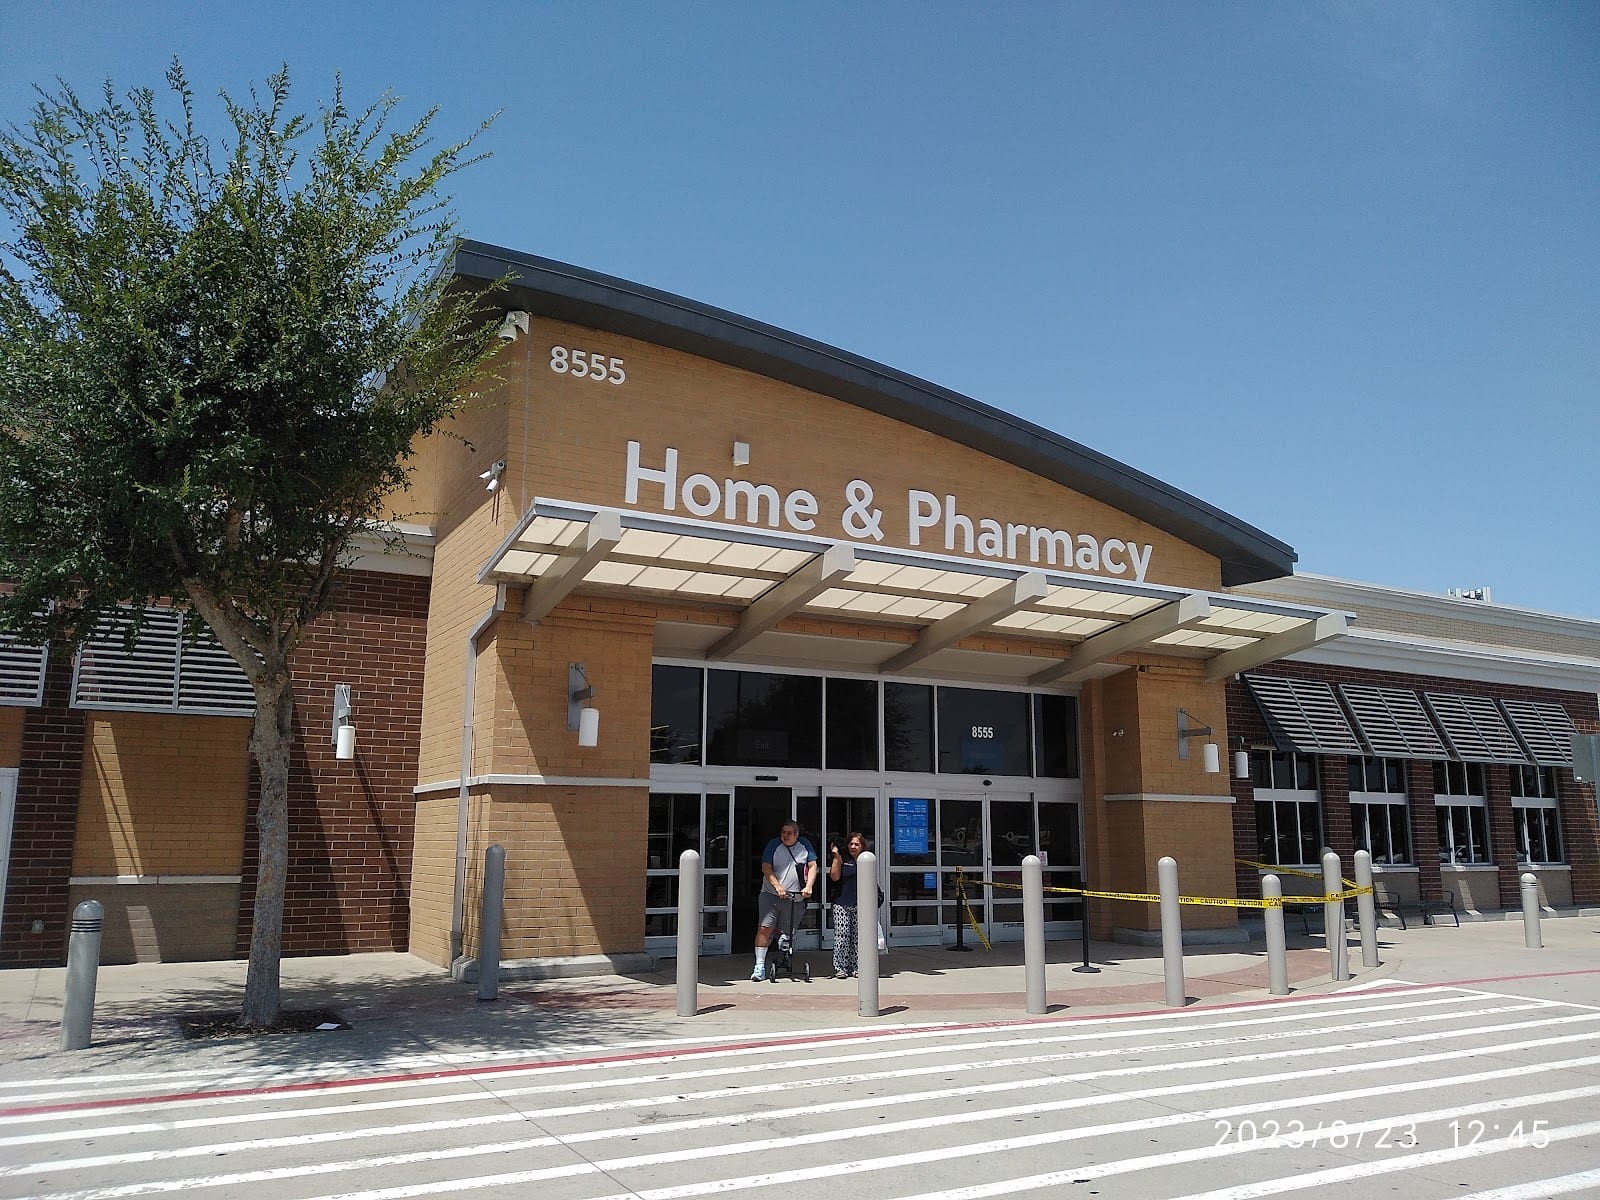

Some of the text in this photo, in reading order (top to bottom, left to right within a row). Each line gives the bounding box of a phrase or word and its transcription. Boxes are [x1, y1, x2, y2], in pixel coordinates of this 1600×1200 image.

[550, 346, 626, 385] 8555
[625, 440, 1153, 584] Home & Pharmacy
[971, 726, 993, 739] 8555
